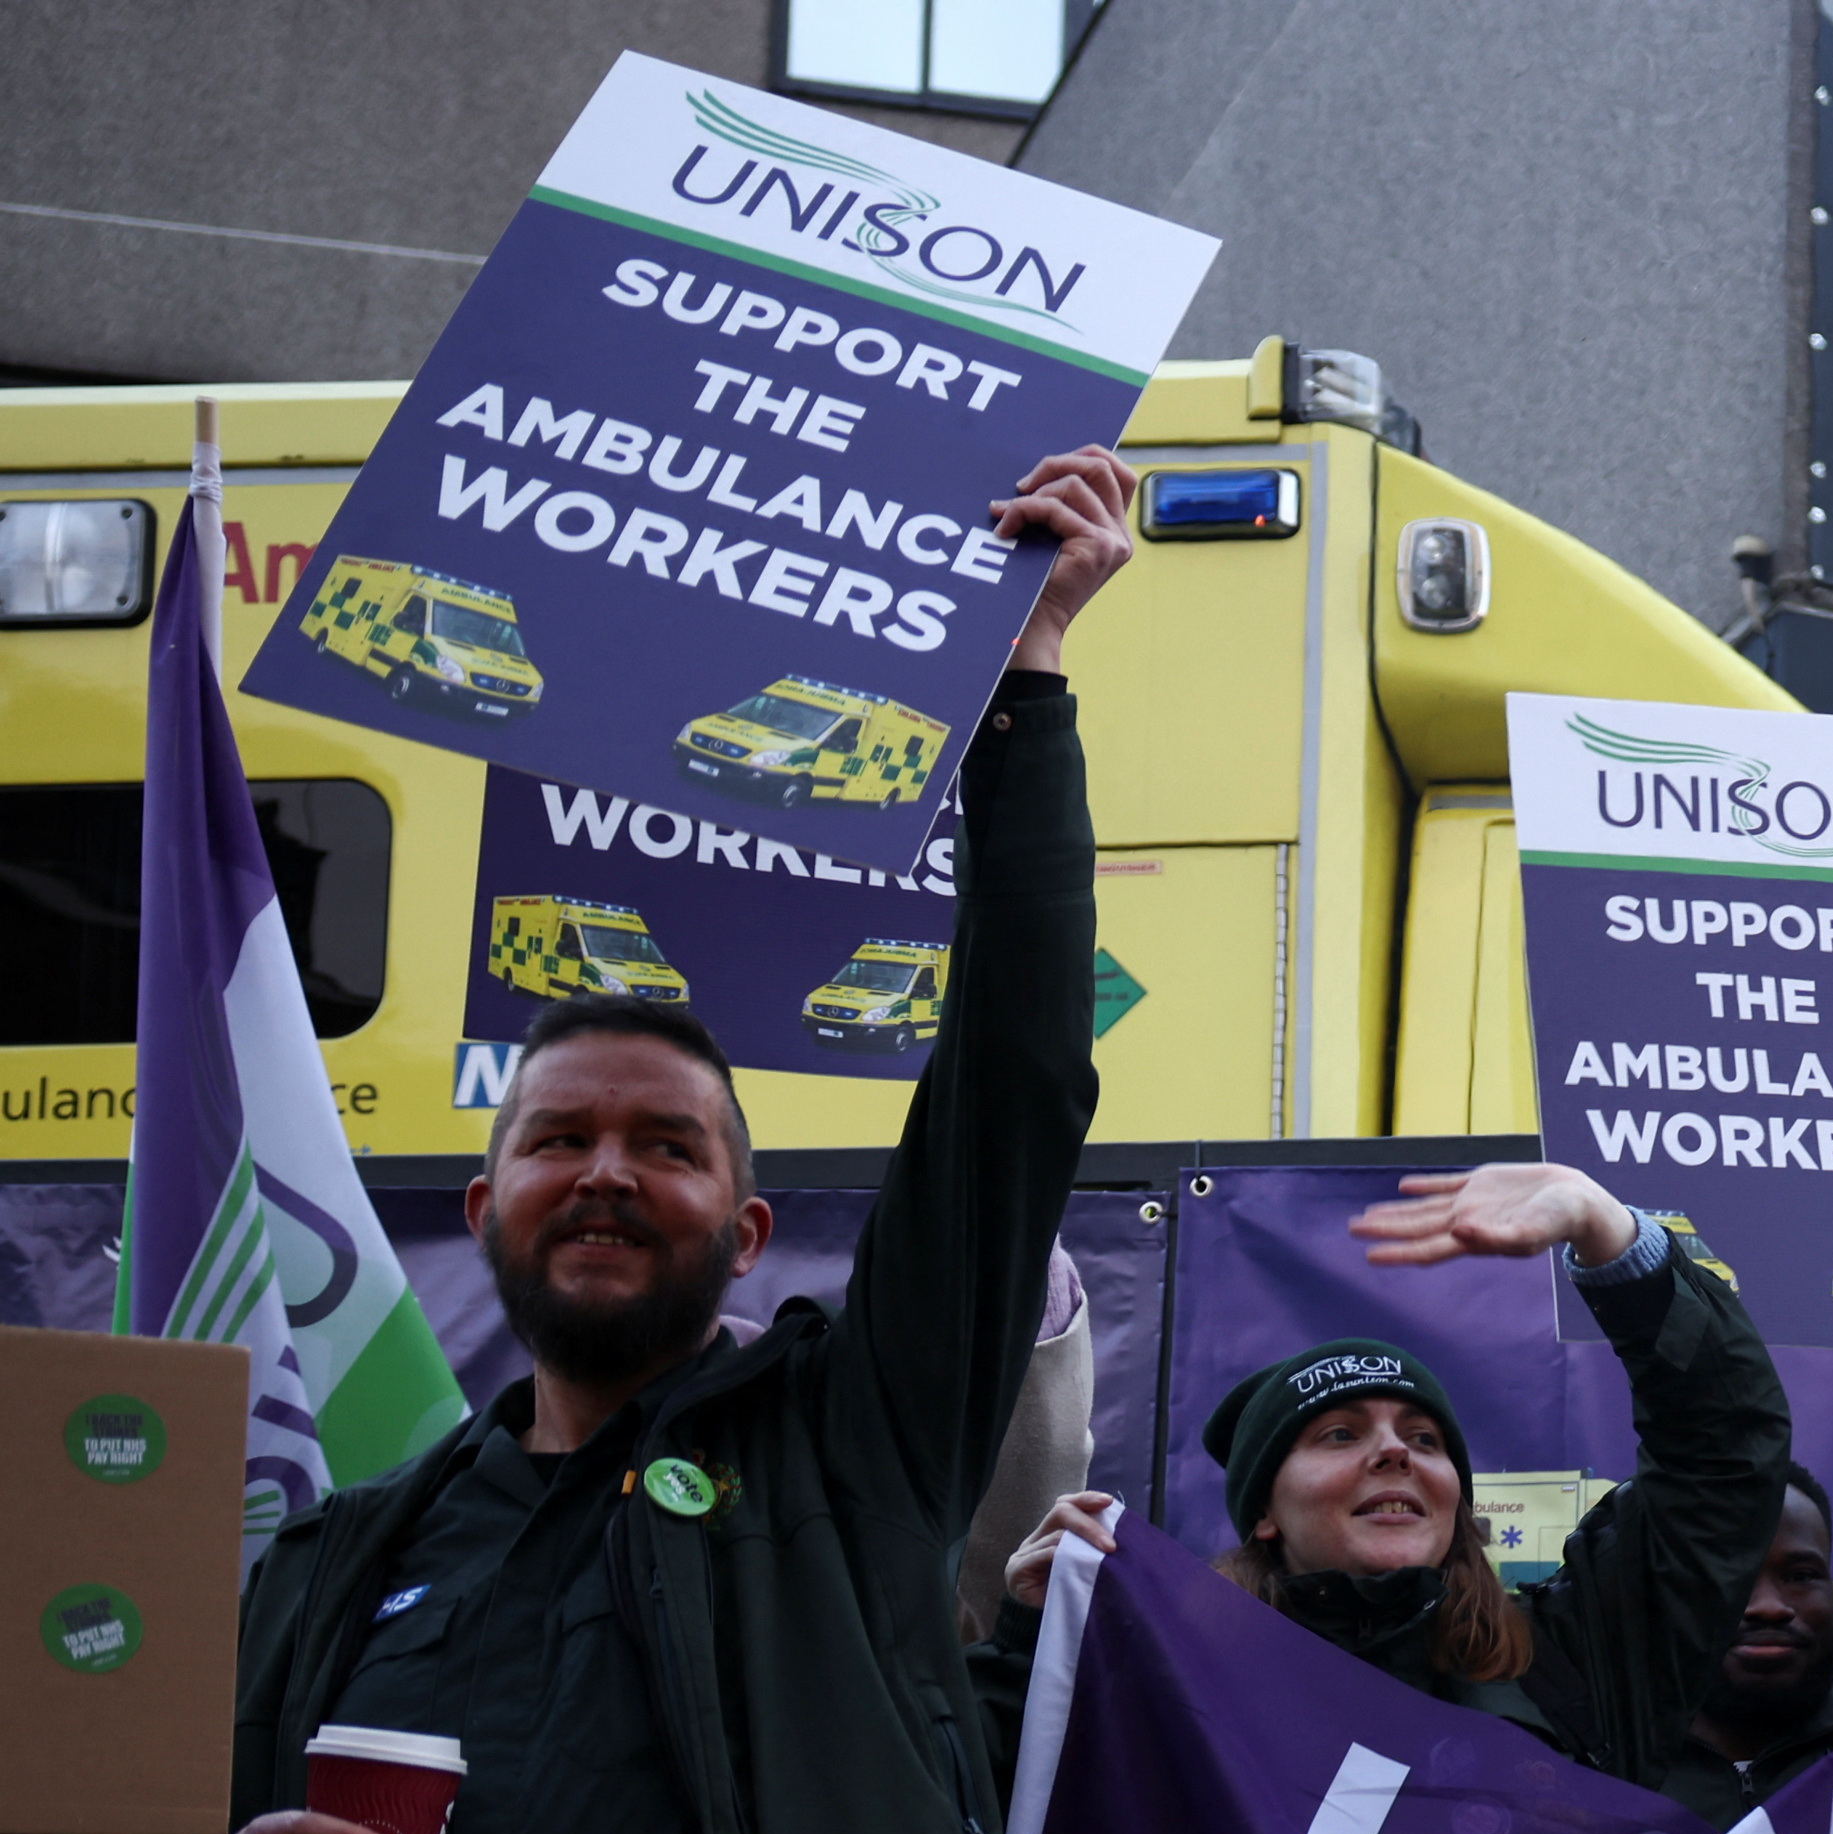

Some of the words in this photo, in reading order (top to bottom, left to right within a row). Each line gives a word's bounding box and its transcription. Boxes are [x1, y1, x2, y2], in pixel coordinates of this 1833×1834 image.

[672, 142, 1087, 313] UNISON
[601, 256, 1021, 412] SUPPORT
[693, 358, 867, 453] THE
[436, 382, 1018, 585] AMBULANCE
[436, 453, 960, 652] WORKERS
[1695, 972, 1820, 1025] THE
[1297, 1355, 1402, 1393] UNISON
[670, 1464, 704, 1503] vote
